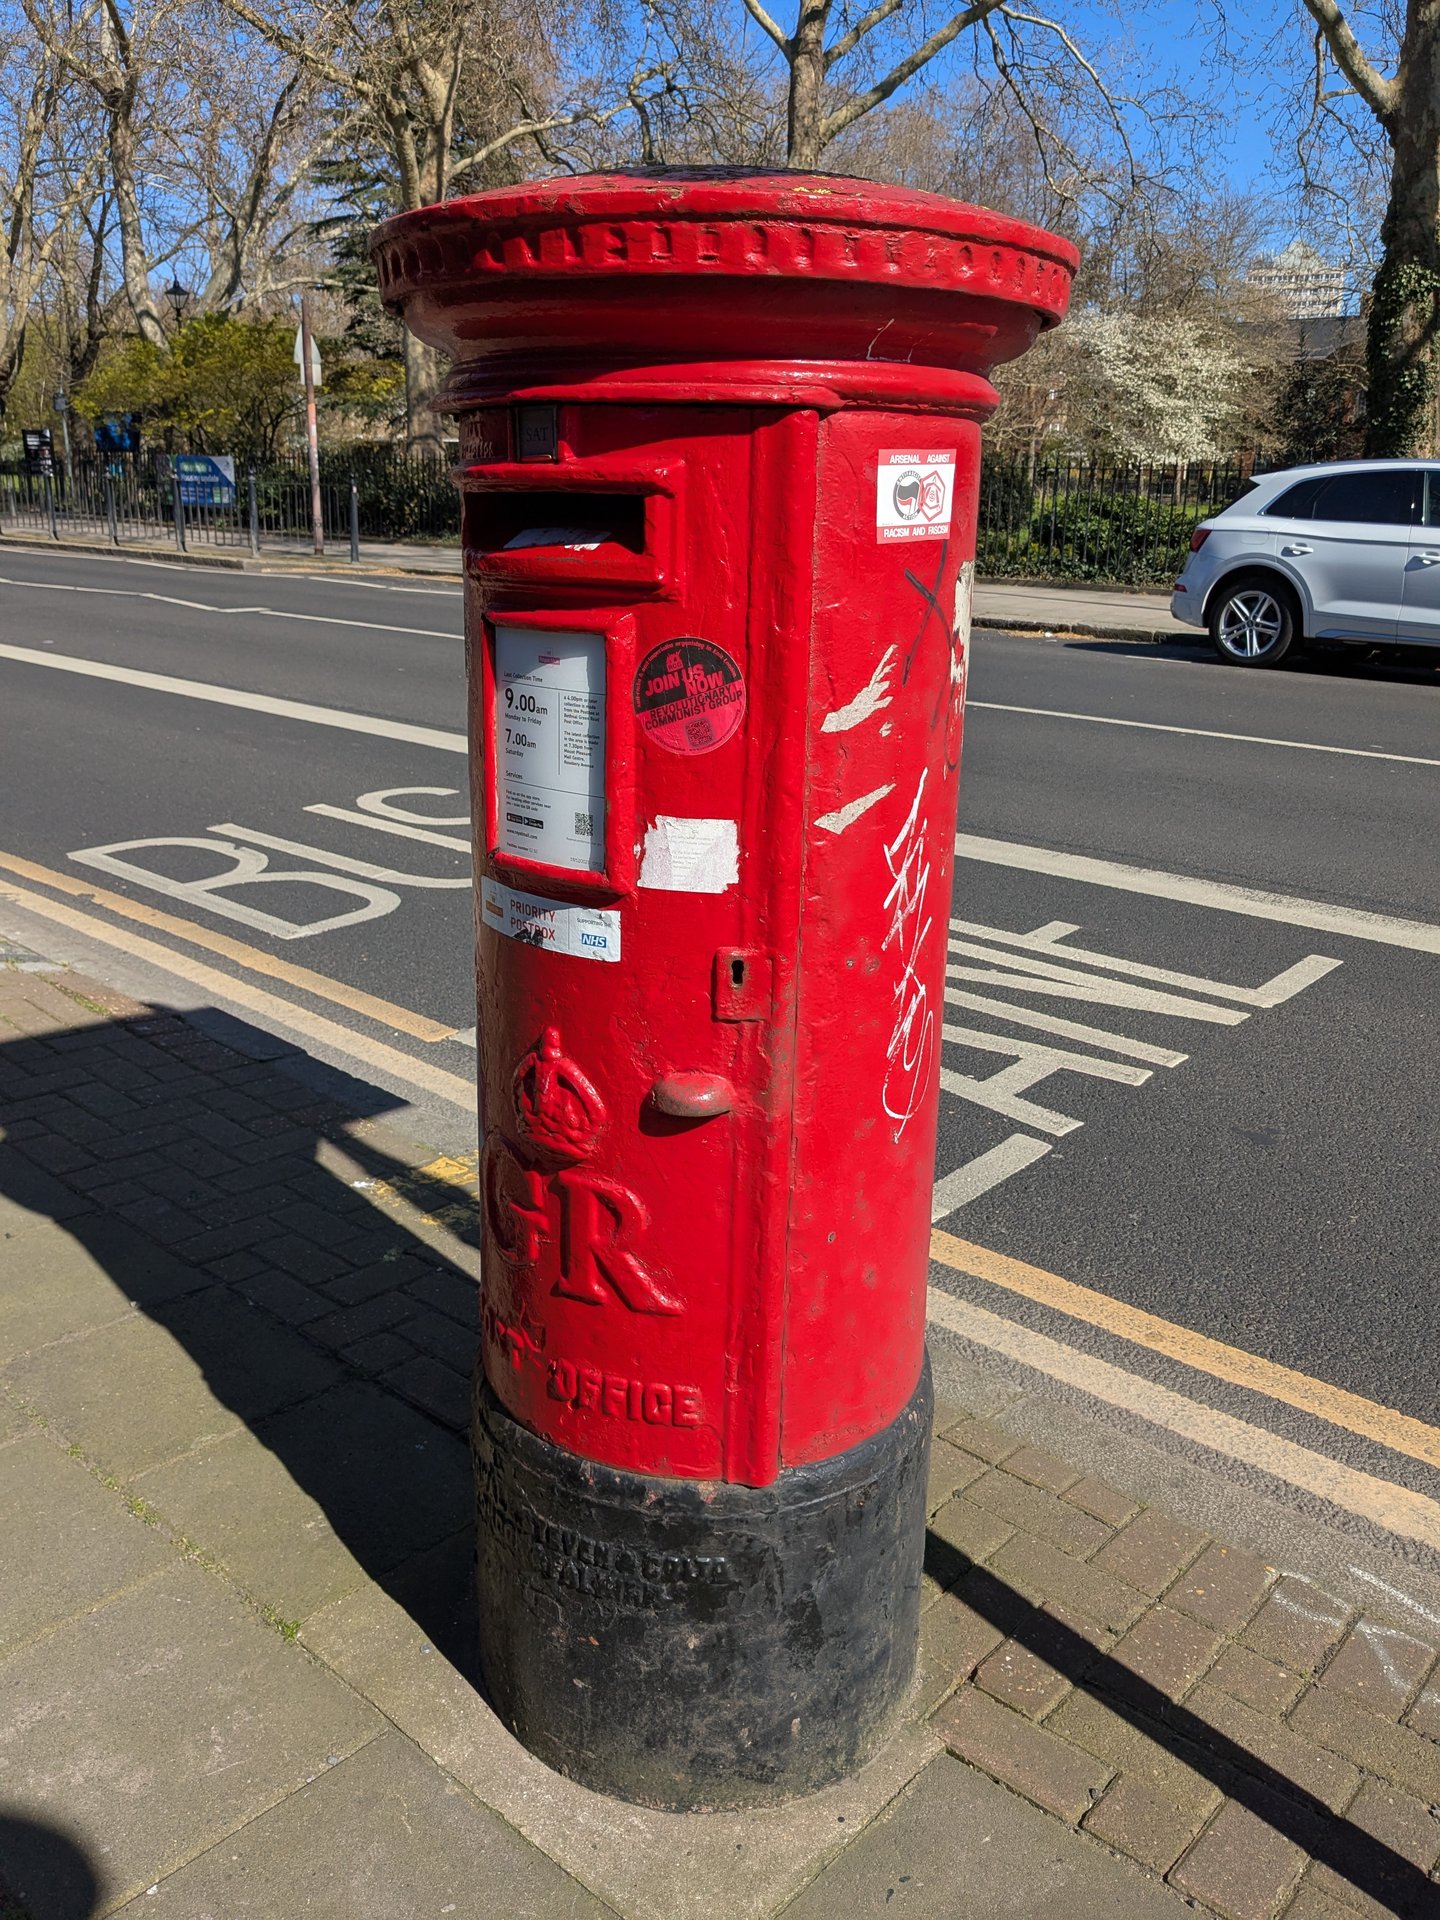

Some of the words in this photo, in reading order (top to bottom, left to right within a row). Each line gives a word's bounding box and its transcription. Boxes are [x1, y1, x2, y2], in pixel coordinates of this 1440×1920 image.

[525, 427, 549, 441] SAT
[889, 453, 921, 464] ARSENAL
[926, 453, 951, 464] AGAINST
[883, 527, 910, 538] RACISM
[912, 526, 926, 536] AND
[928, 524, 949, 535] FASCISM
[532, 675, 543, 683] Time
[645, 671, 680, 697] JOIN
[682, 663, 705, 682] US
[685, 670, 723, 698] NOW
[505, 687, 548, 716] 9.00am
[645, 701, 706, 731] COMMUNIST
[708, 689, 743, 711] GROUP
[650, 685, 734, 720] REVOLUTIONARY
[505, 712, 520, 722] Monday
[528, 716, 542, 726] Friday
[505, 728, 537, 749] 7.00am
[505, 747, 525, 758] Saturday
[506, 770, 523, 780] Services
[511, 899, 556, 922] PRIORITY
[510, 917, 556, 941] POSTBOX
[577, 917, 604, 926] SUPPORTING
[583, 934, 606, 947] NHS
[549, 1357, 703, 1428] OFFICE
